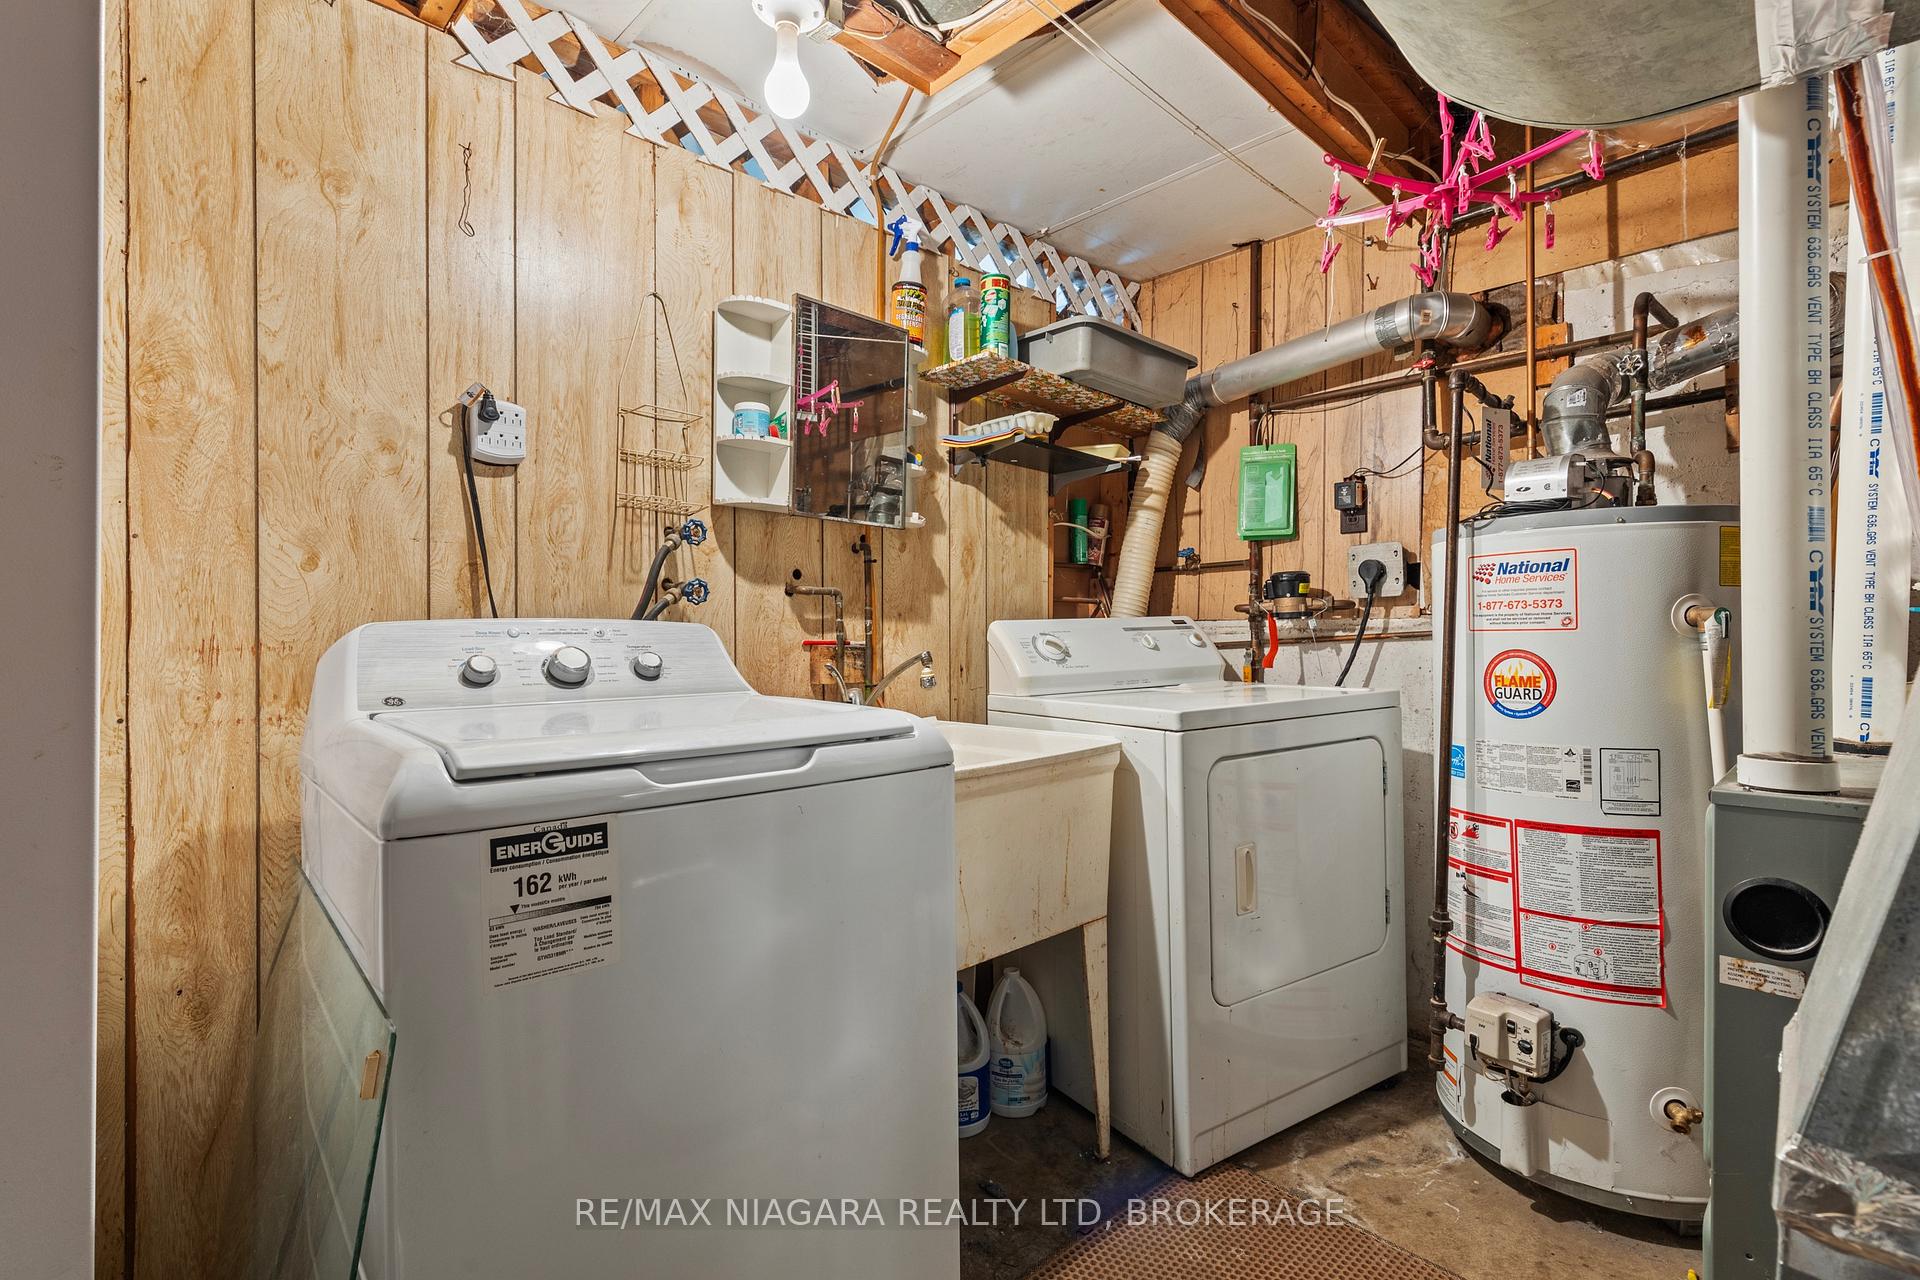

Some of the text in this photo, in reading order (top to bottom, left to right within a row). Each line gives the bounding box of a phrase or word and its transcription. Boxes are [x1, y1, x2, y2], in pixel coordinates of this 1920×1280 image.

[1807, 186, 1822, 230] SYSTEM
[1807, 237, 1822, 259] 636
[1807, 266, 1822, 287] GAS
[1807, 296, 1822, 324] VENT
[1807, 334, 1822, 362] TYPE
[1807, 370, 1822, 384] BH
[1808, 392, 1823, 428] CLASS
[1808, 437, 1822, 459] IIA
[1808, 466, 1823, 496] 65°C
[1867, 483, 1879, 510] SYSTEM
[1867, 514, 1878, 528] 636
[1866, 531, 1877, 545] GAS
[1496, 557, 1571, 576] National
[1865, 549, 1876, 567] VENT
[1494, 573, 1566, 585] Home Services
[1865, 572, 1875, 589] TYPE
[1478, 598, 1563, 610] 1-877-673-5373
[1864, 593, 1874, 603] BH
[1863, 606, 1874, 630] CLASS
[1809, 617, 1824, 662] SYSTEM
[1862, 651, 1872, 670] 65°C
[1494, 675, 1541, 688] FLAME
[1810, 669, 1824, 691] 636
[1494, 687, 1542, 700] GUARD
[1810, 697, 1825, 719] GAS
[1810, 727, 1825, 758] VENT
[533, 822, 568, 833] Canada
[496, 831, 604, 860] ENERGUIDE
[490, 866, 508, 874] Energy
[509, 861, 541, 870] consumption
[546, 854, 581, 865] Consommation
[513, 872, 577, 898] 162 kWh
